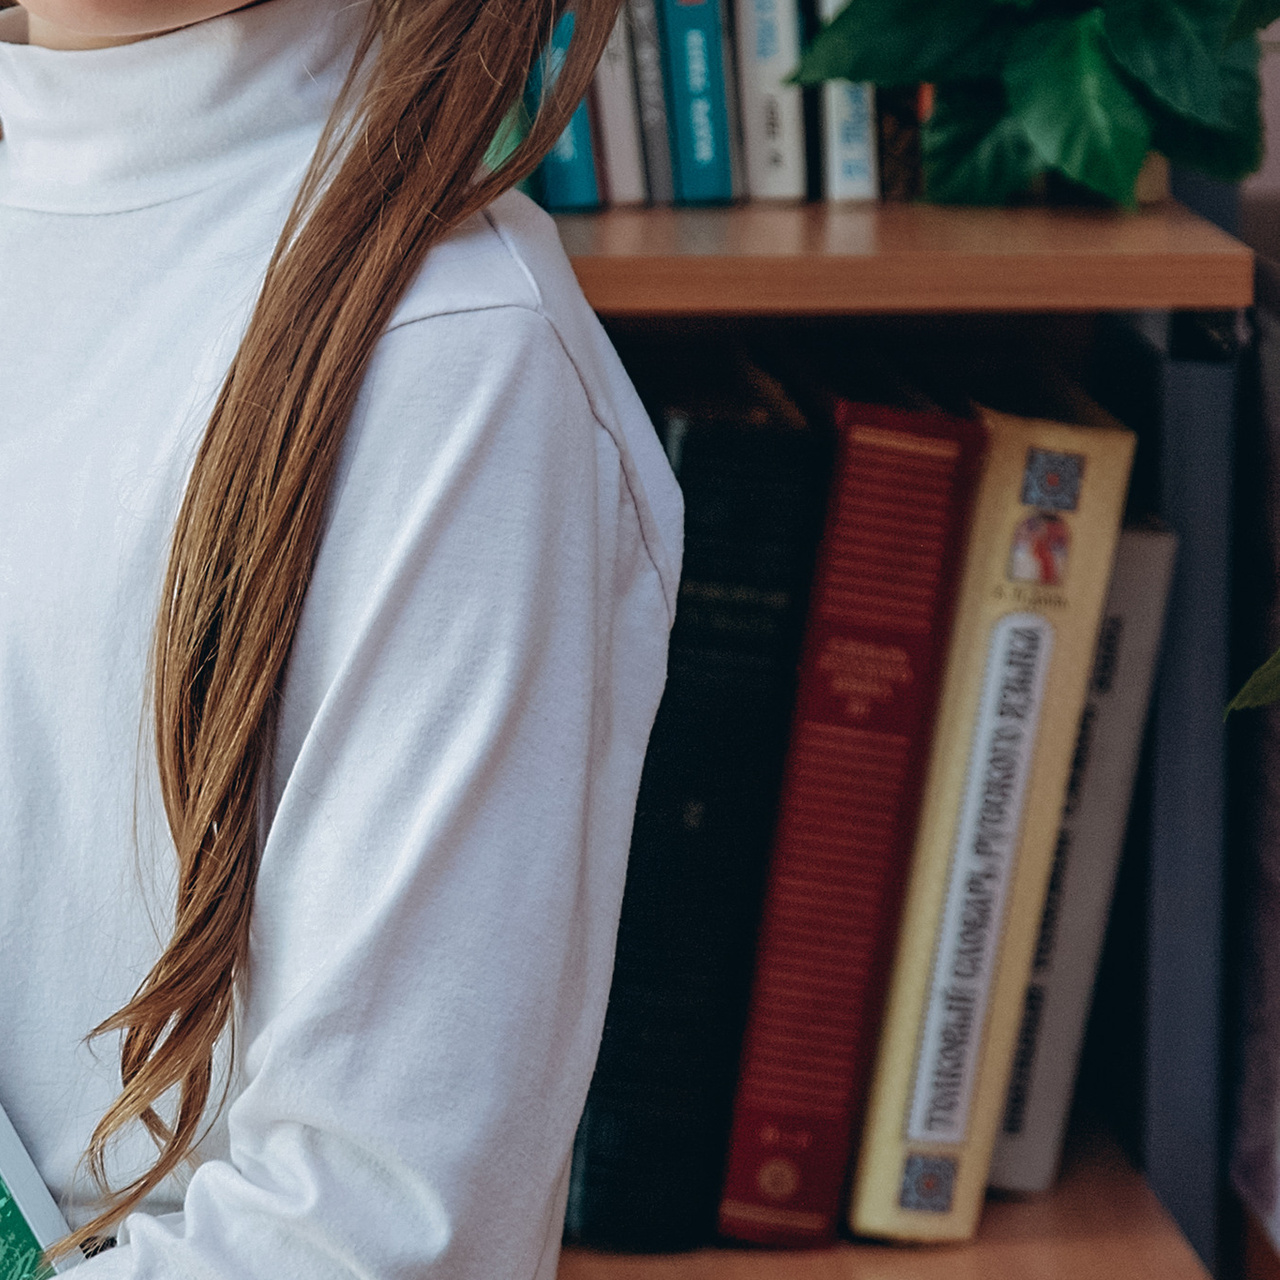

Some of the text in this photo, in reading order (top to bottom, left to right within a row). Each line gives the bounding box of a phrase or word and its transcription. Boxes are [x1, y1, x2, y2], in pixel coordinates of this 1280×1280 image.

[972, 726, 1027, 862] РУССКОГО
[951, 866, 1000, 982] СЛОВАРЬ
[926, 984, 979, 1133] ТОЛКОВЫЙ
